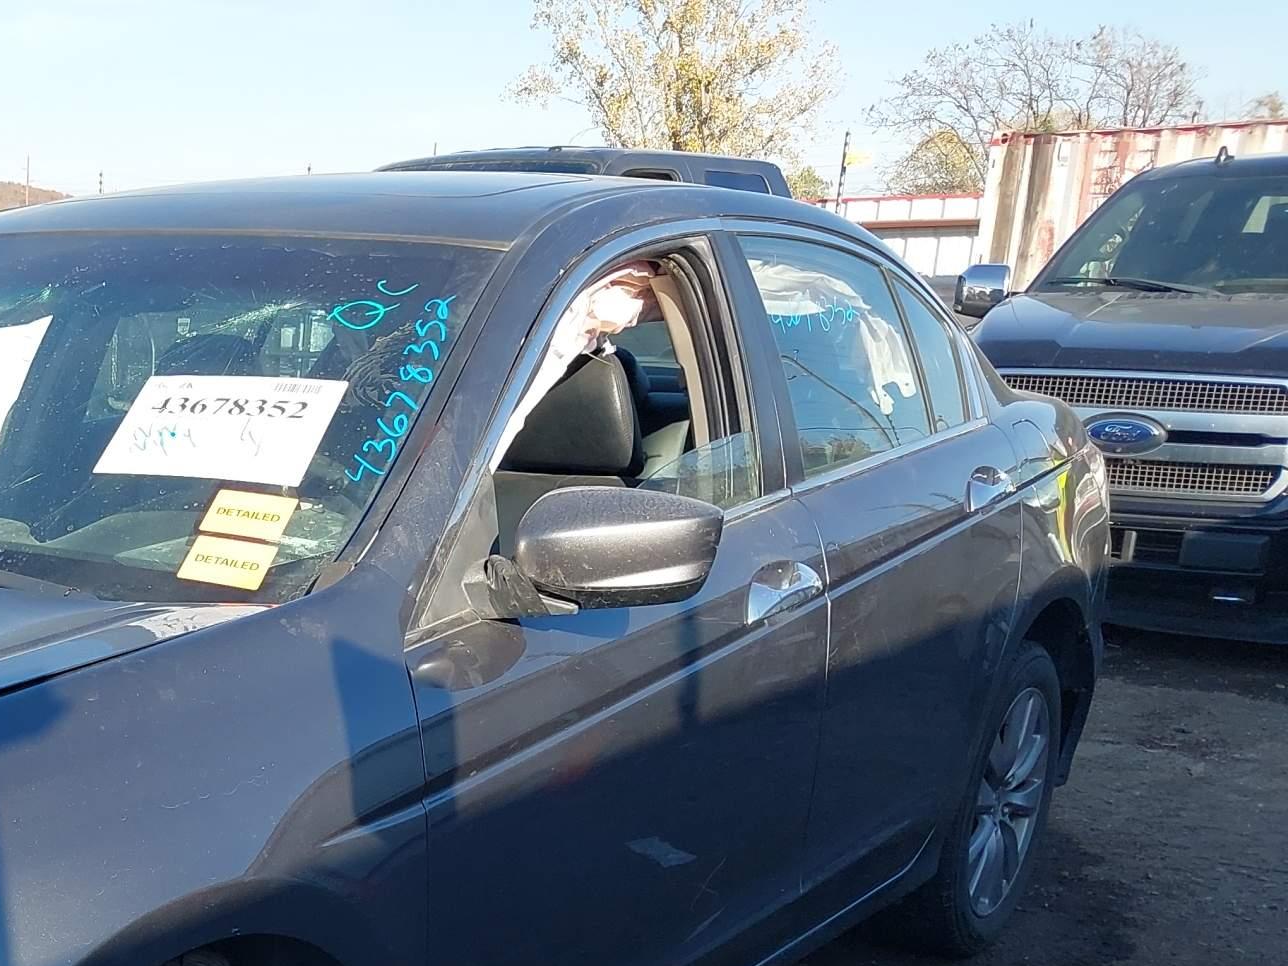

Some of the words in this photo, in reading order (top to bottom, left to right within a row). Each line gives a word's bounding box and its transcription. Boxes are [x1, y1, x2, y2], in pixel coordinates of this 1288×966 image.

[344, 295, 457, 482] 43678352
[152, 397, 309, 419] 43678352
[1100, 424, 1142, 441] Ford
[216, 507, 281, 522] DETAILED
[194, 553, 260, 571] DETAILED
